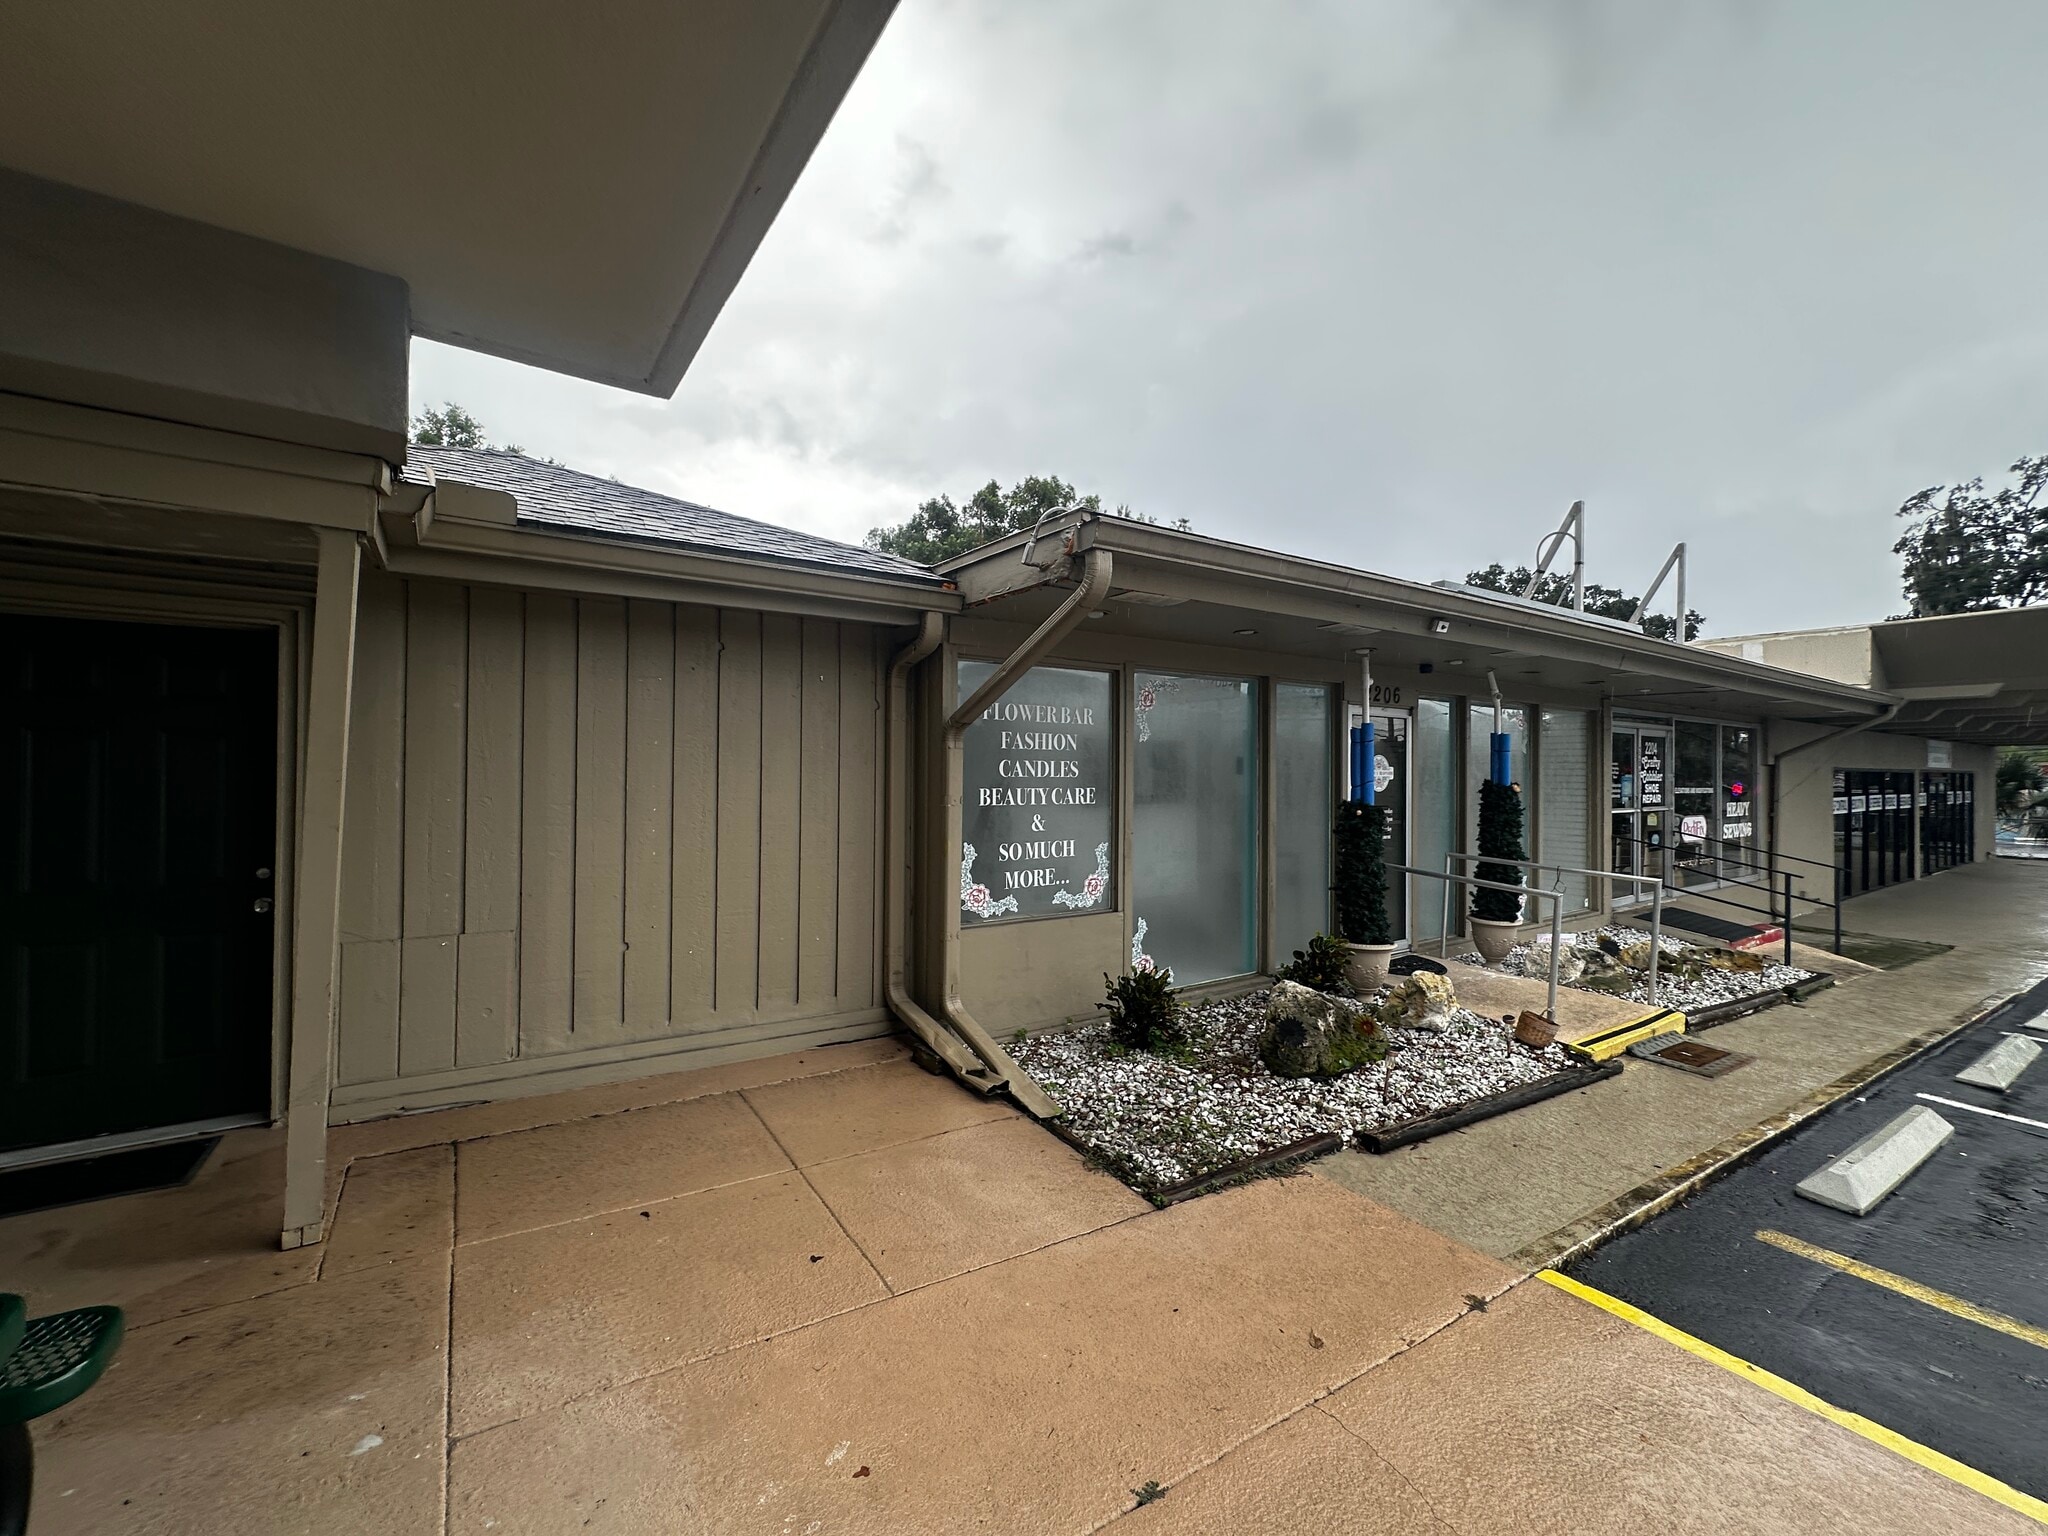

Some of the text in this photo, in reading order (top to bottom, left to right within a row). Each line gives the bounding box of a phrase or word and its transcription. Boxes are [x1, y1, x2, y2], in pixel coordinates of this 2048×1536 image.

[1369, 685, 1401, 704] 206
[982, 703, 1095, 725] FLOWER BAR
[1000, 731, 1077, 750] FASHION
[998, 760, 1079, 778] CANDLES
[978, 787, 1096, 807] BEAUTY CARE
[1644, 784, 1660, 793] SHOE
[1642, 794, 1662, 804] REPAIR
[1726, 801, 1750, 817] HEAVY
[1031, 813, 1046, 831] &
[1723, 822, 1752, 839] SEWING
[998, 839, 1076, 862] SO MUCH
[1004, 868, 1070, 890] MORE...
